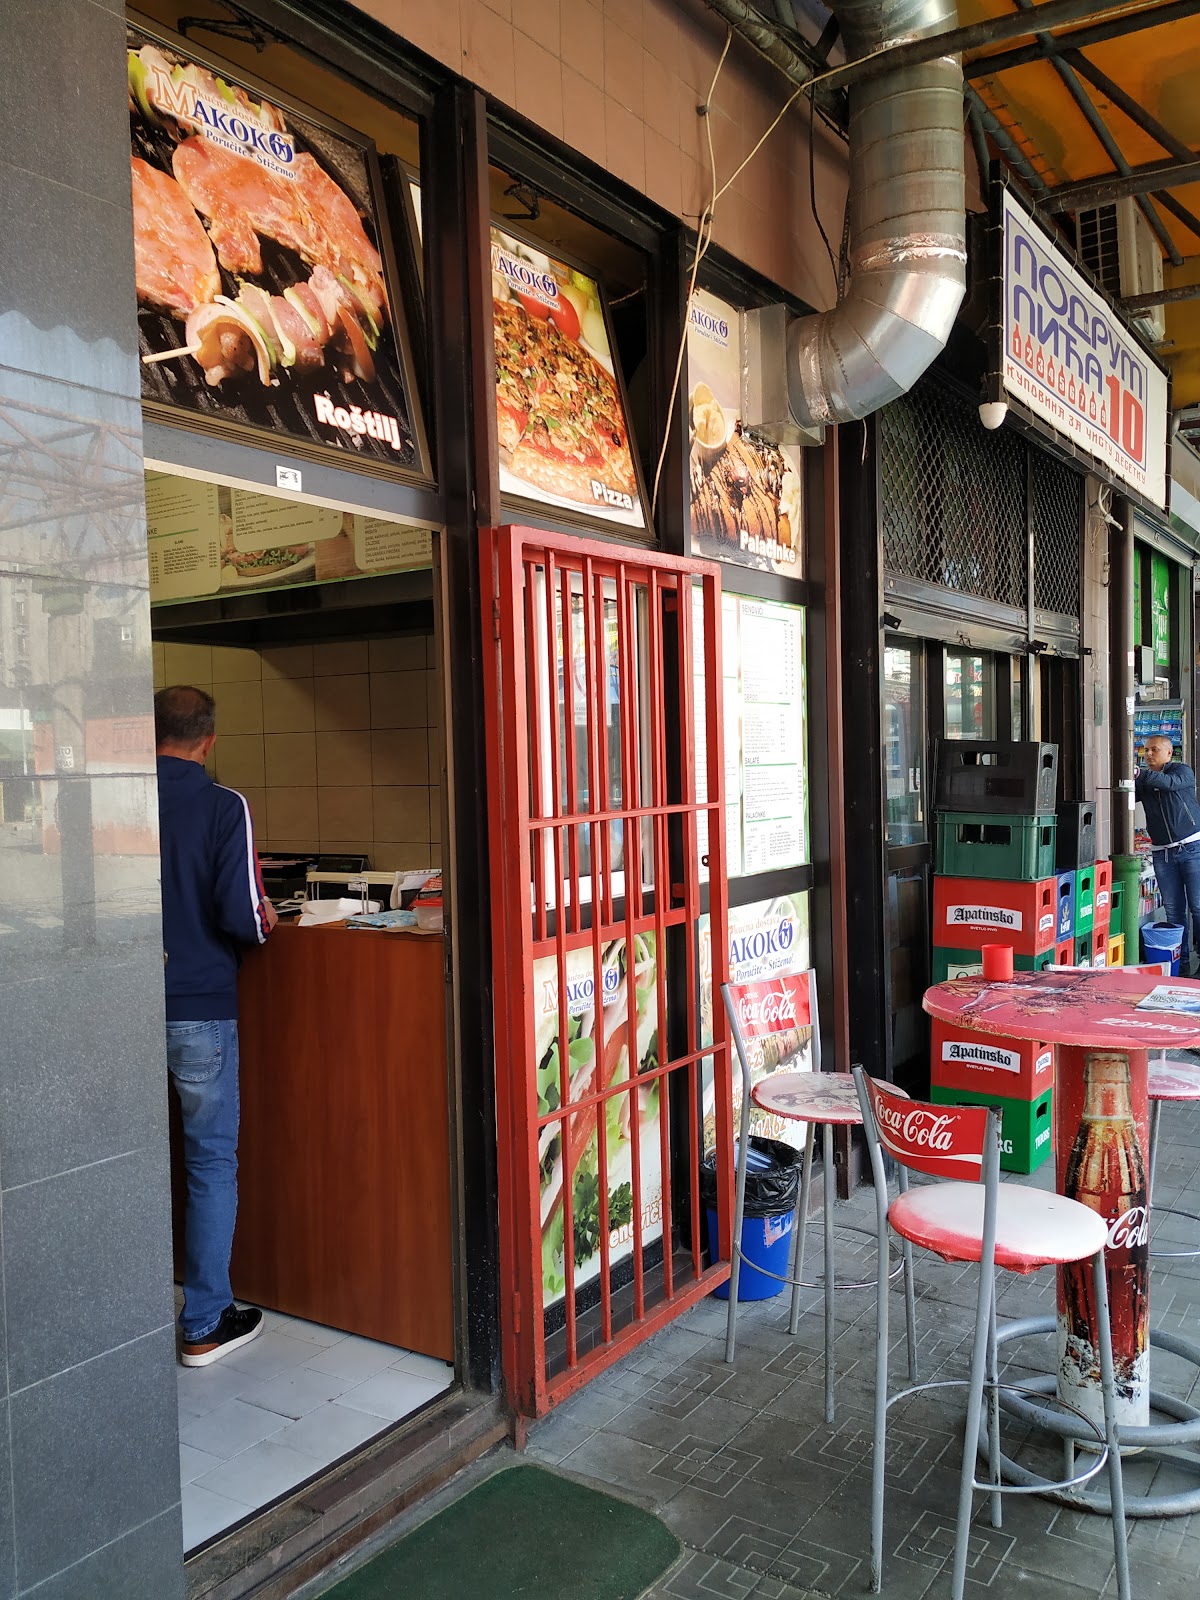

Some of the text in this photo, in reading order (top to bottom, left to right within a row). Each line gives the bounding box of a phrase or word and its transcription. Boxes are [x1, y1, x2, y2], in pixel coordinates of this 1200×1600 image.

[151, 64, 293, 163] MAKOKO
[198, 89, 269, 132] kučna dostava
[205, 129, 247, 156] Poručite
[257, 154, 298, 181] Stižemo!
[1014, 234, 1143, 400] ПОДРУМ
[1013, 284, 1144, 463] ПИЋА 10
[314, 394, 401, 450] Roštilj
[1007, 363, 1146, 485] КУПОВИНА ЗА ЧИСТУ ДЕСЕТКУ
[591, 480, 633, 510] Pizza
[740, 530, 796, 564] Palačinke
[954, 907, 1014, 925] Apatinsko
[736, 965, 763, 981] Poručite
[768, 953, 794, 971] Stižemo!
[949, 1044, 1012, 1066] Apatinsko
[874, 1095, 956, 1151] Coca-Cola
